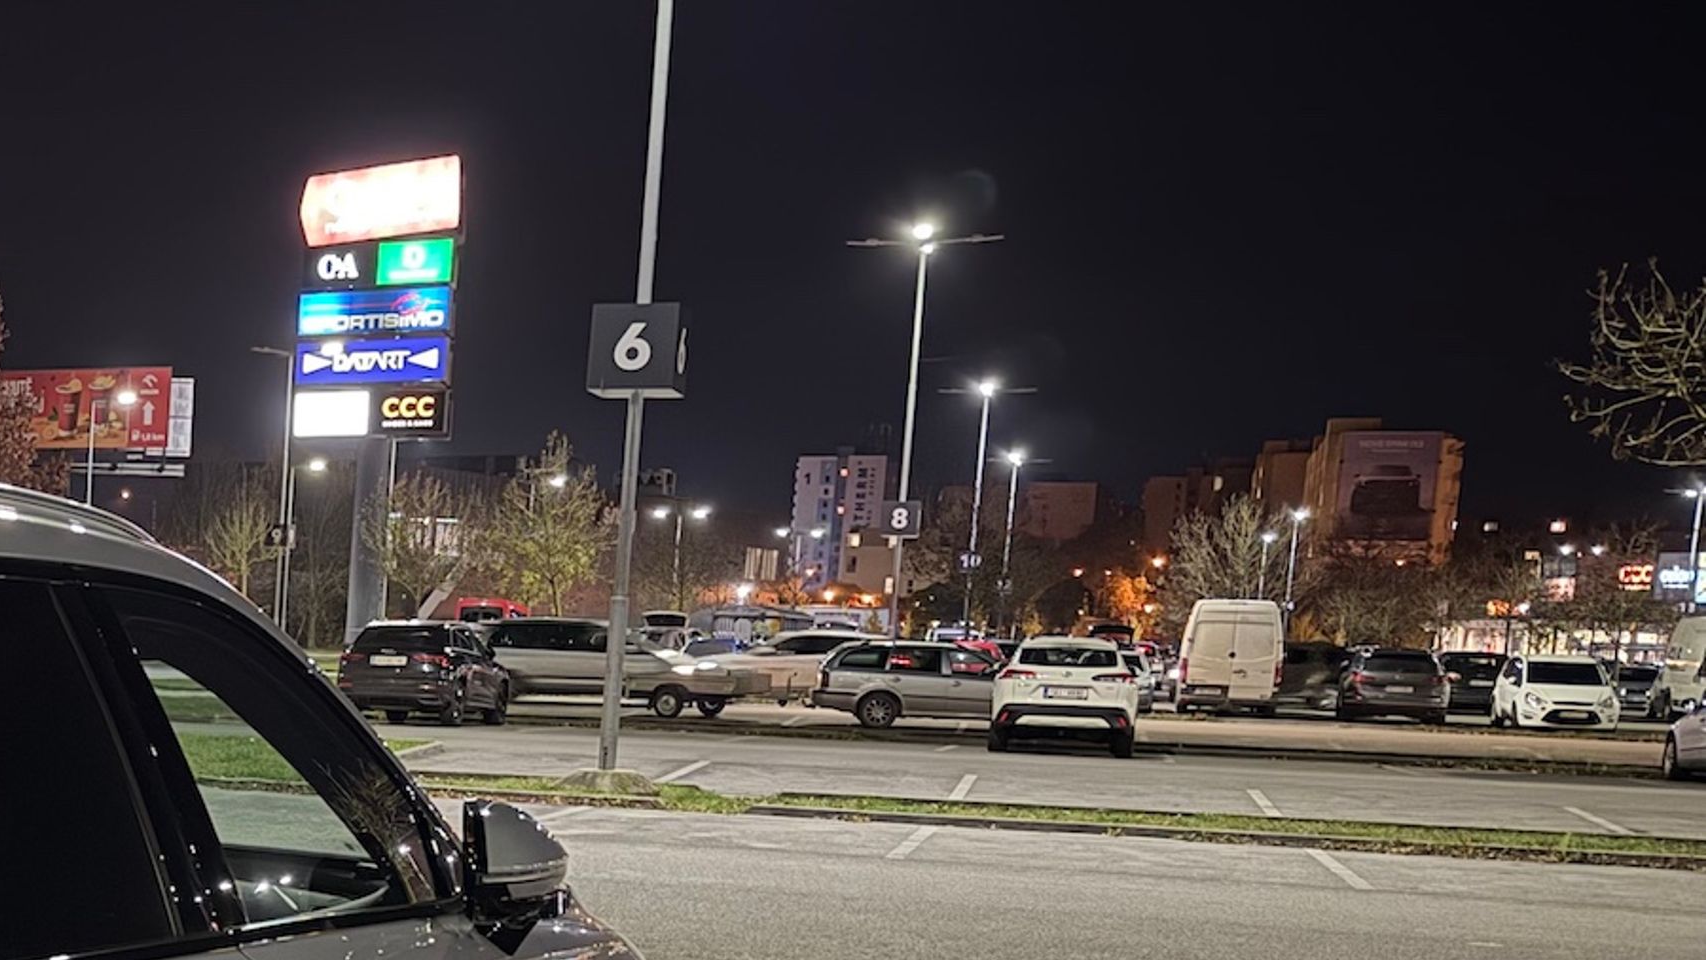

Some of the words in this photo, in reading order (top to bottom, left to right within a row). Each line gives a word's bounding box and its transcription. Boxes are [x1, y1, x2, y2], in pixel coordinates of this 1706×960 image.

[302, 309, 445, 333] ORTISIMO
[613, 322, 648, 371] 6
[381, 396, 435, 418] CCC
[890, 507, 909, 530] 8
[959, 553, 982, 568] 10
